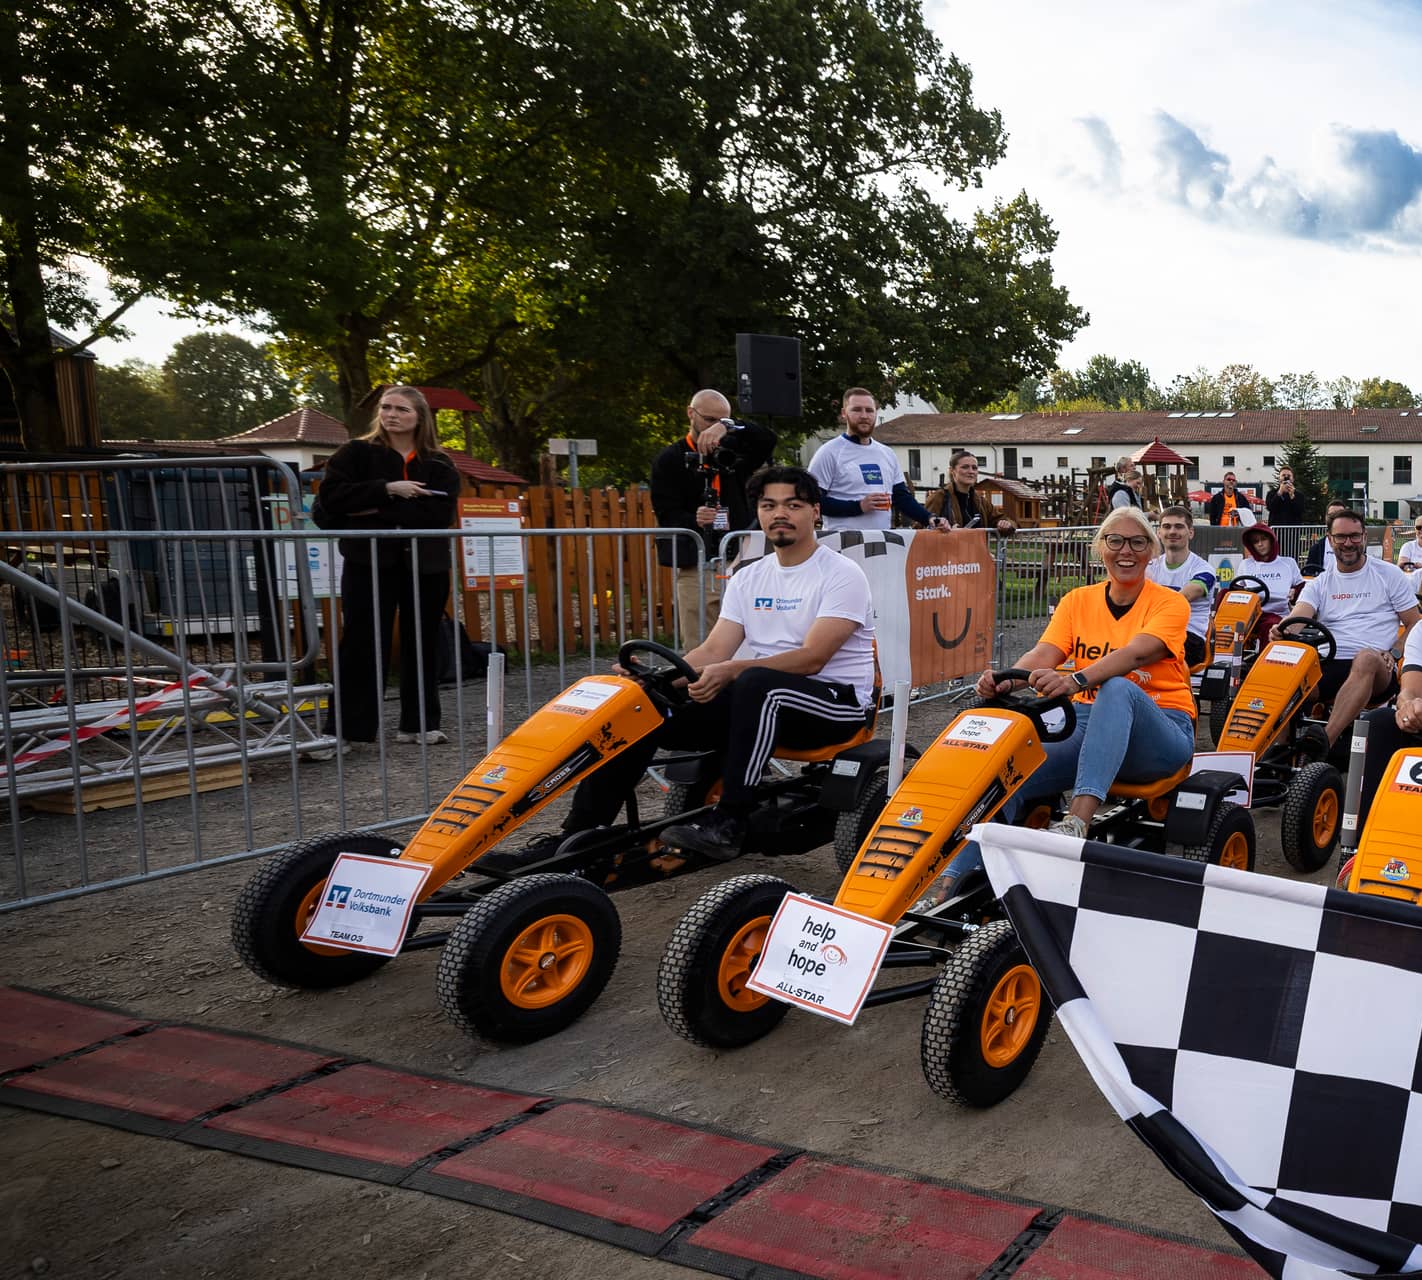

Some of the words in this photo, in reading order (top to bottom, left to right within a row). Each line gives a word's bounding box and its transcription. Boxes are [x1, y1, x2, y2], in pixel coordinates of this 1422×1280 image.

[915, 561, 981, 580] gemeinsam
[915, 584, 952, 601] stark.
[1075, 636, 1120, 660] hel
[942, 739, 989, 751] ALL-STAR
[353, 888, 407, 906] Dortmunder
[349, 900, 393, 917] Volksbank
[329, 930, 350, 940] TEAM
[802, 916, 836, 944] help
[798, 938, 818, 952] and
[787, 949, 826, 976] hope
[775, 981, 825, 1005] ALL-STAR
